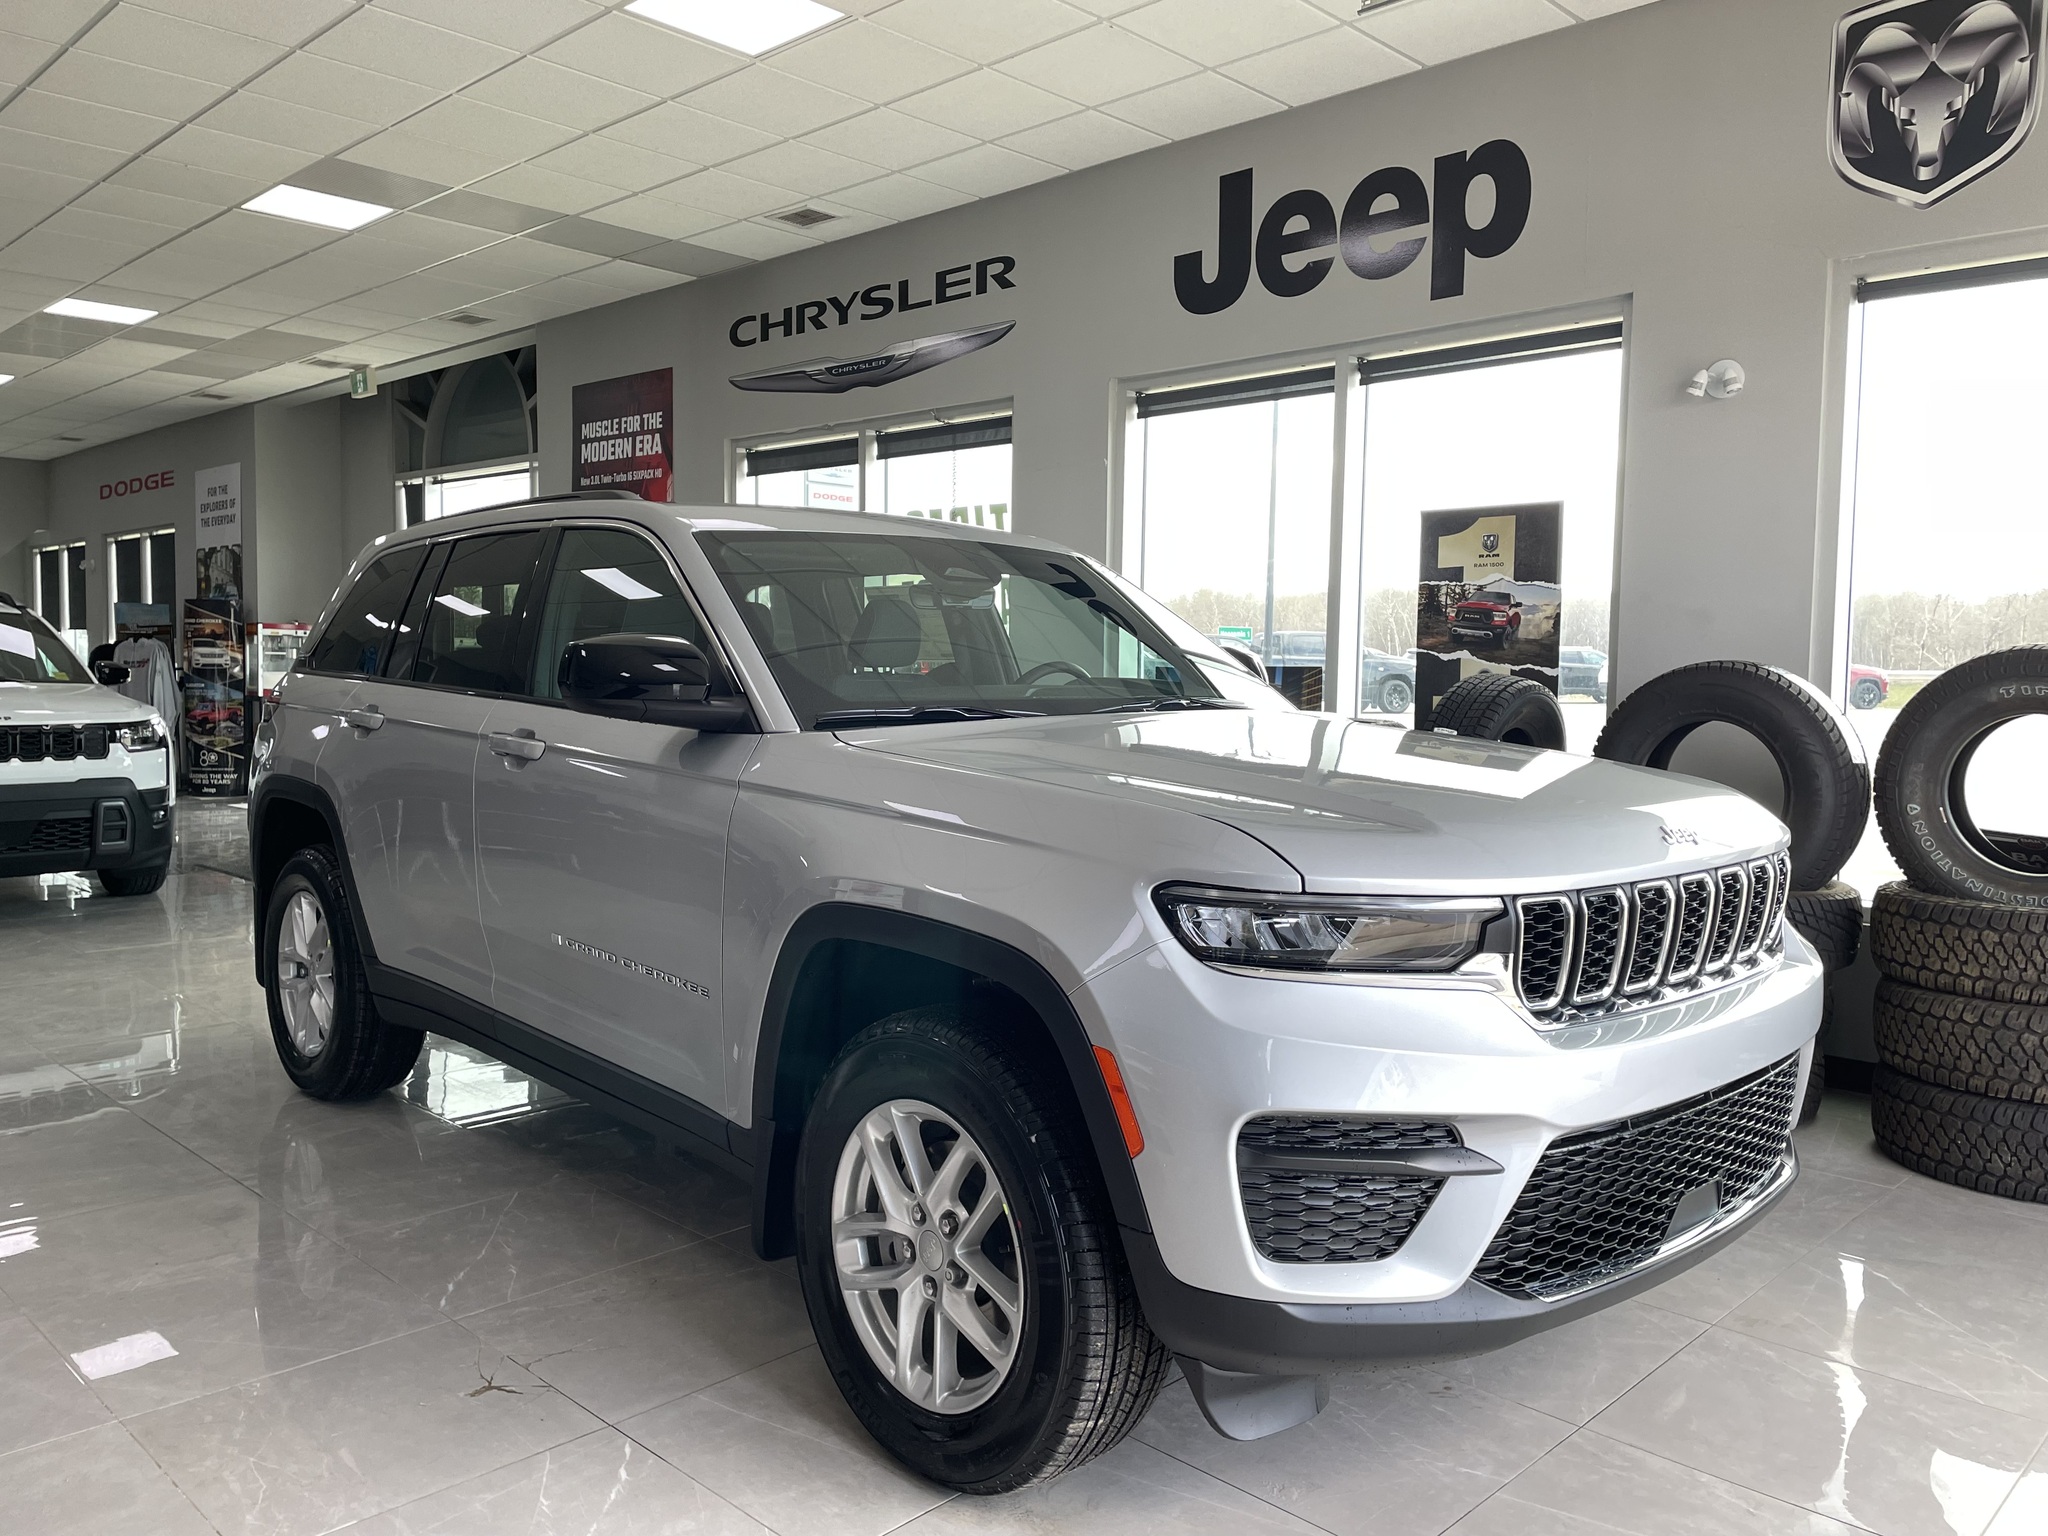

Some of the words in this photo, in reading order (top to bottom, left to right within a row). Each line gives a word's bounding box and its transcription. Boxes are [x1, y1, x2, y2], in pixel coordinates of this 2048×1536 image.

[1174, 138, 1531, 315] Jeep
[729, 255, 1017, 348] CHRYSLER
[832, 359, 887, 374] CHRYSLER
[581, 418, 619, 440] MUSCLE
[621, 415, 641, 434] FOR
[642, 411, 663, 430] THE
[581, 437, 632, 464] MODERN
[635, 433, 662, 457] ERA
[99, 470, 175, 500] DODGE
[601, 472, 627, 483] Twin-Turbo
[207, 487, 217, 497] FOR
[218, 484, 228, 495] THE
[813, 492, 853, 503] DODGE
[200, 500, 228, 513] EXPLORERS
[229, 498, 236, 508] OF
[200, 517, 210, 528] THE
[211, 514, 236, 527] EVERYDAY
[1658, 825, 1699, 846] Jeep
[565, 937, 617, 964] GRAND
[621, 956, 711, 1000] CHEROKEE
